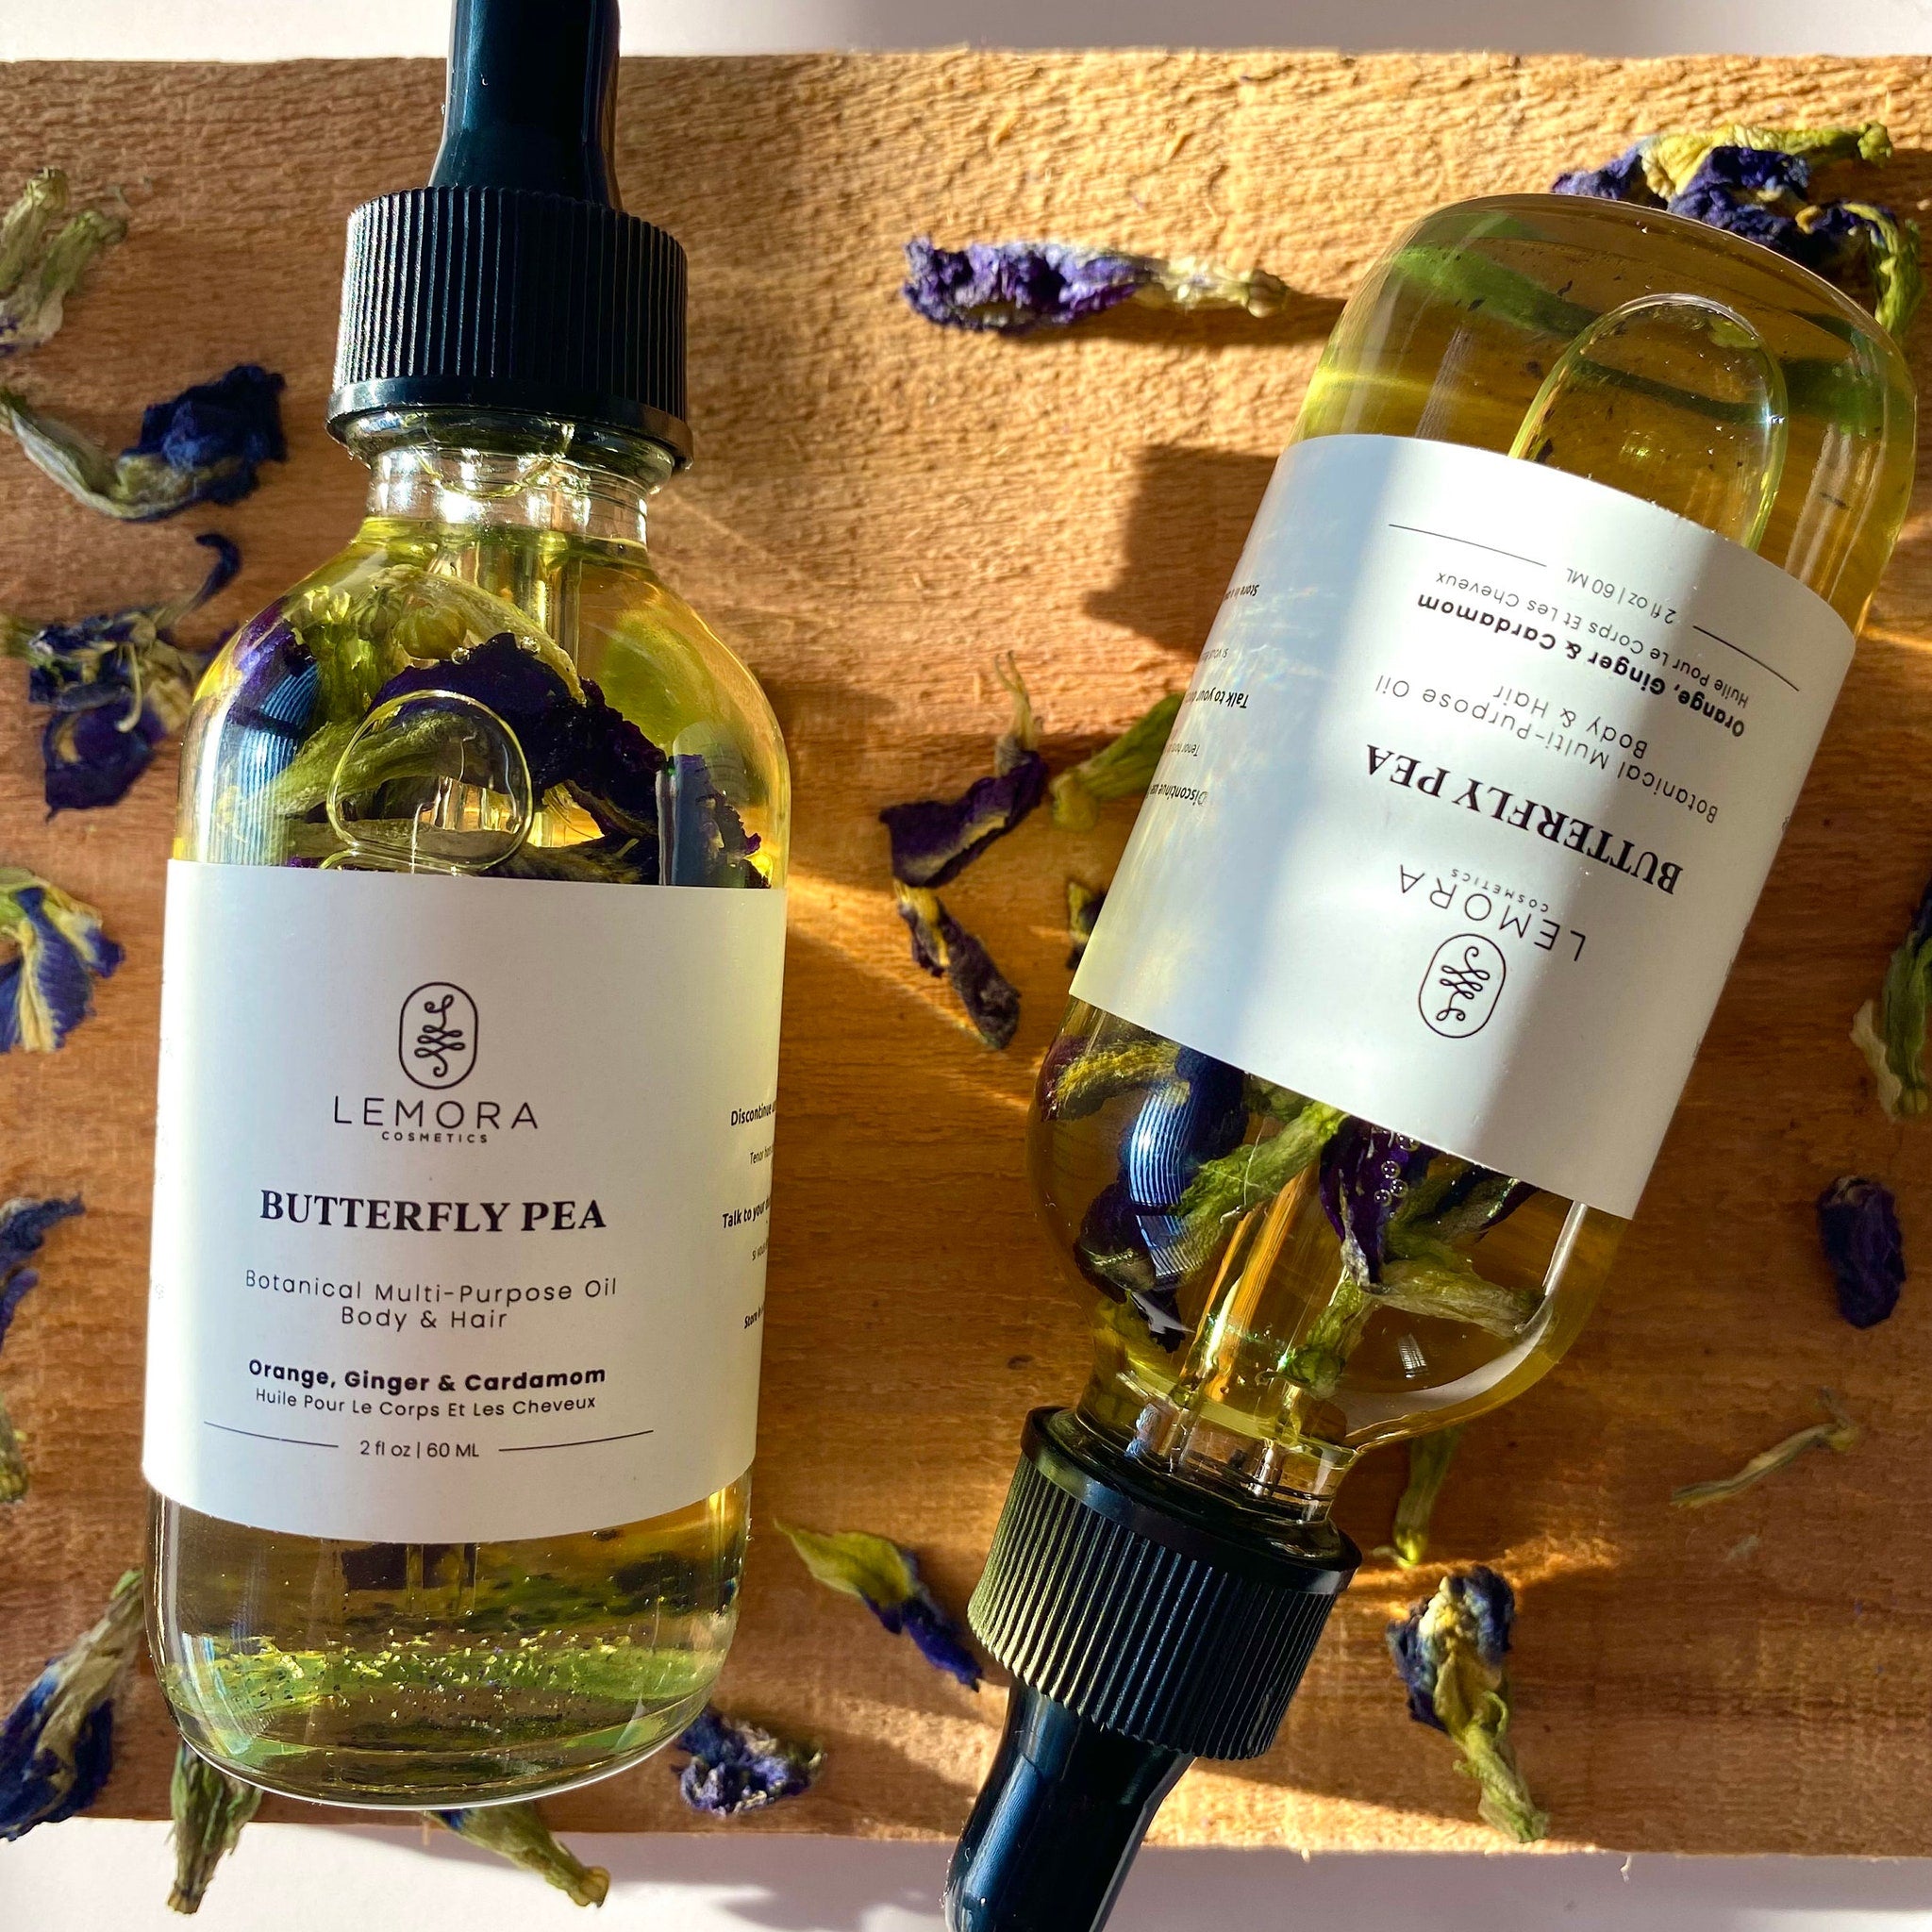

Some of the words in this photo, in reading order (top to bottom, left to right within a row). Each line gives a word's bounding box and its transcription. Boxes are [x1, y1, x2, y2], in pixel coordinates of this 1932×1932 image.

[1436, 573, 1519, 607] Cheveux
[1567, 568, 1589, 589] ML
[1591, 579, 1615, 598] 60
[1527, 600, 1557, 622] Les
[1627, 592, 1648, 609] oz
[1650, 603, 1662, 618] fl
[1418, 594, 1556, 650] Cardamom
[1563, 612, 1582, 630] Et
[1665, 608, 1676, 625] 2
[1564, 641, 1582, 659] &
[1588, 622, 1643, 654] Corps
[1650, 648, 1669, 666] Le
[1375, 675, 1409, 697] Oil
[1587, 650, 1666, 695] Ginger
[1672, 658, 1710, 688] Pour
[1196, 688, 1216, 702] your
[1214, 691, 1225, 706] to
[1225, 692, 1249, 709] Talk
[1492, 686, 1549, 719] Hair
[1714, 679, 1749, 708] Huile
[1559, 708, 1576, 728] &
[1674, 684, 1744, 737] Orange,
[1423, 689, 1609, 770] Multi-Purpose
[1586, 716, 1647, 759] Body
[1367, 744, 1451, 799] PEA
[1158, 784, 1208, 808] Discontinue
[1618, 761, 1718, 824] Botanical
[1451, 777, 1684, 895] BUTTERFLY
[1451, 869, 1548, 912] COSMETICS
[1400, 864, 1586, 961] LEMORA
[334, 1095, 538, 1129] LEMORA
[381, 1131, 487, 1143] COSMETICS
[259, 1190, 511, 1232] BUTTERFLY
[521, 1199, 607, 1231] PEA
[723, 1208, 742, 1228] Talk
[743, 1208, 752, 1223] to
[246, 1270, 360, 1300] Botanical
[375, 1284, 572, 1307] Multi-Purpose
[585, 1277, 616, 1298] Oil
[341, 1306, 408, 1332] Body
[420, 1309, 437, 1328] &
[451, 1309, 508, 1328] Hair
[249, 1358, 336, 1388] Orange,
[344, 1370, 430, 1396] Ginger
[437, 1374, 456, 1393] &
[463, 1369, 606, 1392] Cardamom
[256, 1387, 298, 1407] Huile
[304, 1394, 346, 1412] Pour
[353, 1399, 373, 1414] Le
[378, 1401, 440, 1421] Corps
[447, 1403, 466, 1417] Et
[474, 1403, 505, 1417] Les
[512, 1397, 595, 1415] Cheveux
[360, 1440, 370, 1456] 2
[375, 1441, 385, 1456] fl
[391, 1444, 411, 1457] oz
[426, 1442, 450, 1457] 60
[456, 1443, 479, 1457] ML
